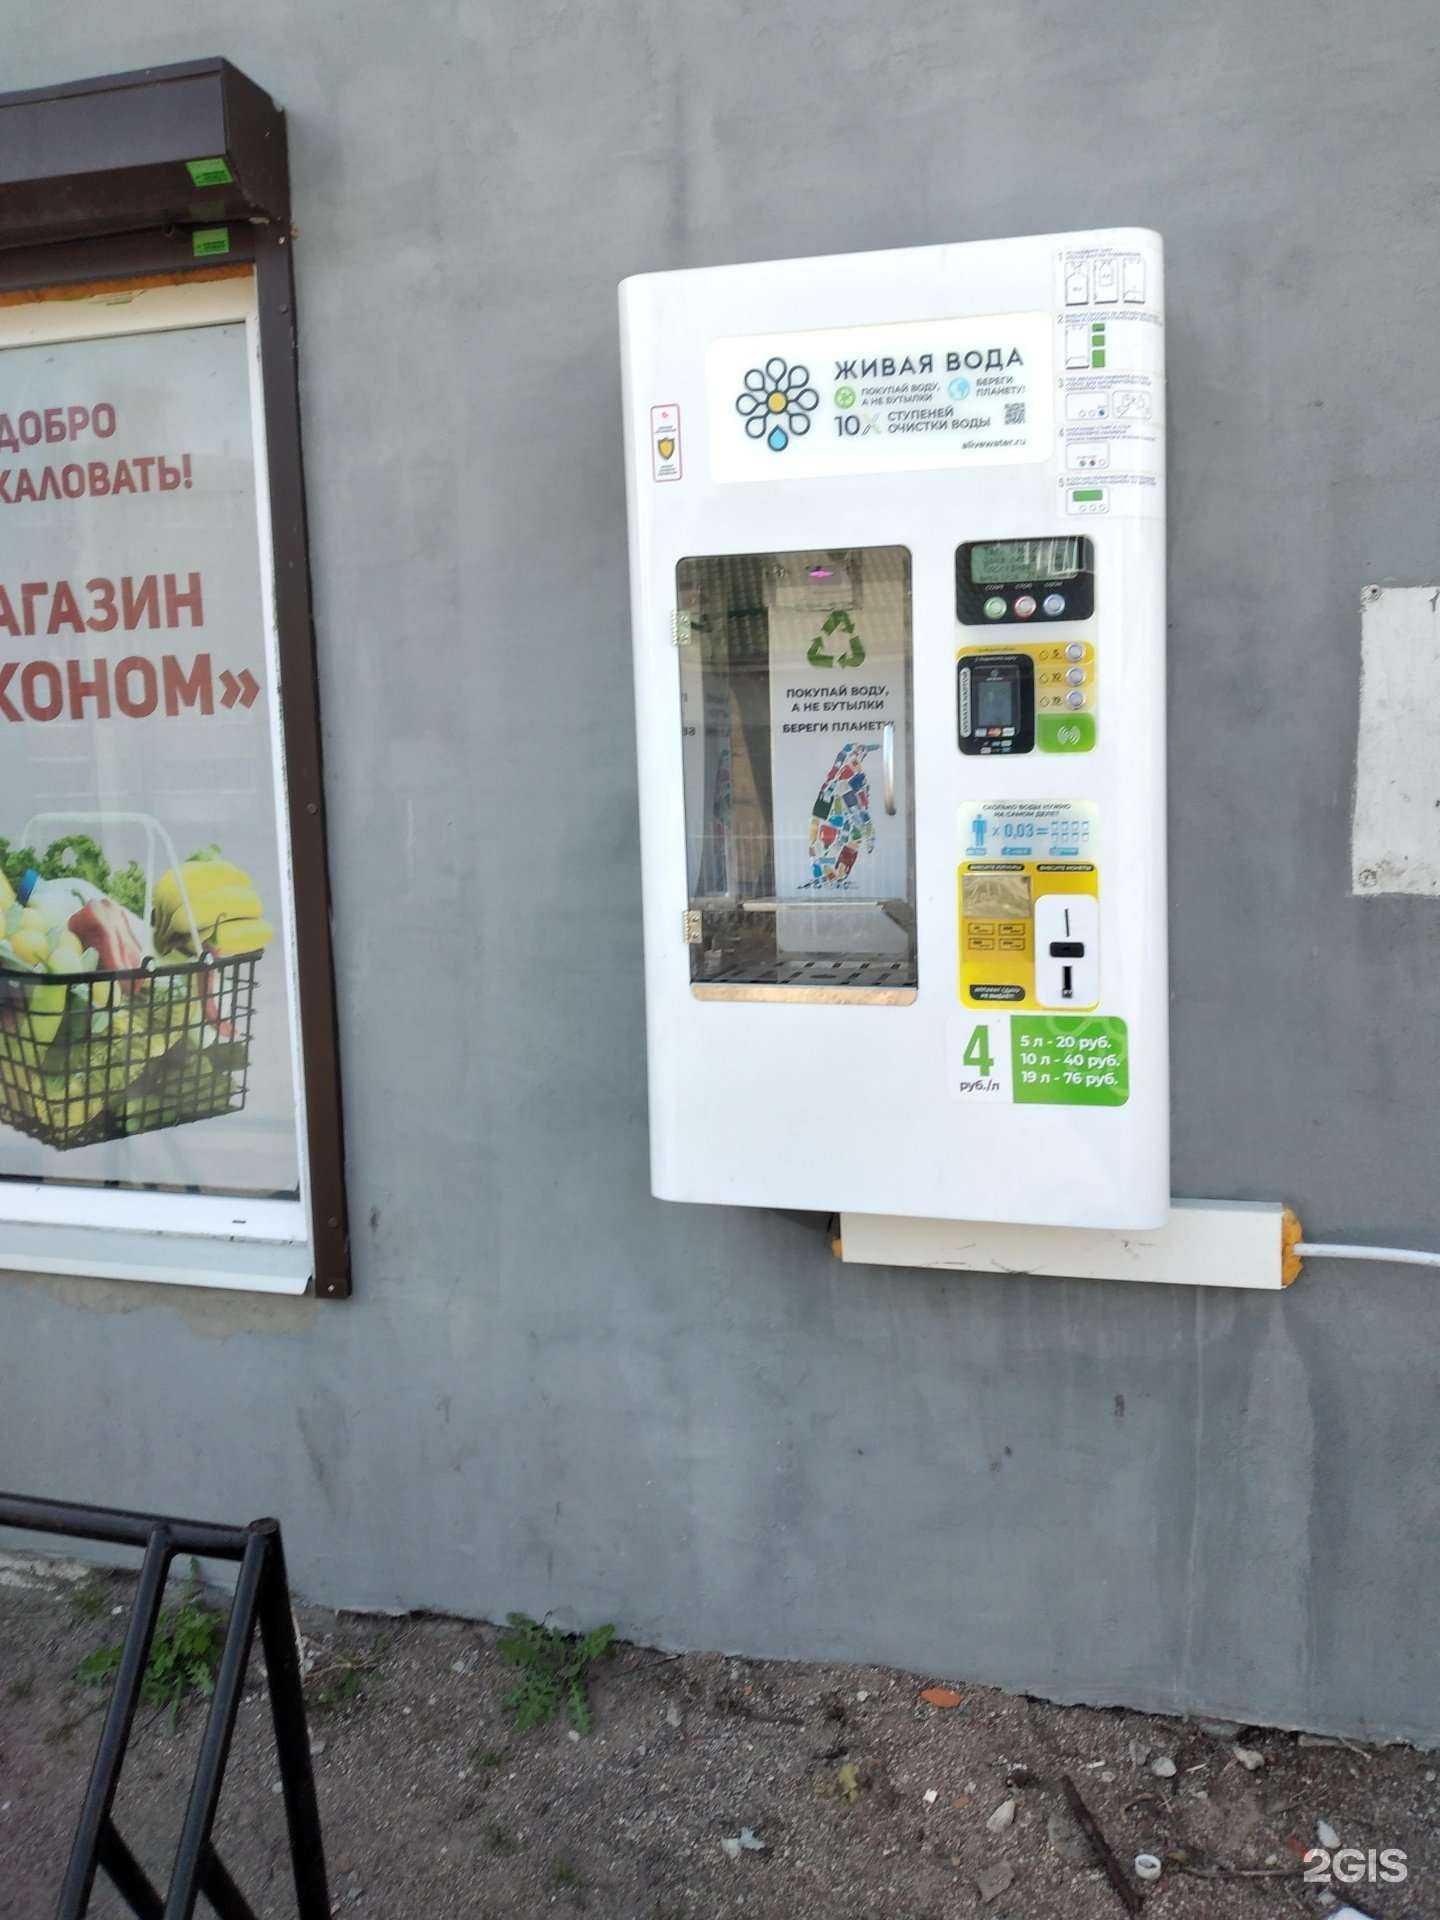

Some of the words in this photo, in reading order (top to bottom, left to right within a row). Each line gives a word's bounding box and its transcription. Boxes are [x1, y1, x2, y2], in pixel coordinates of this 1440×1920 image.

[834, 353, 934, 381] ЖИВАЯ
[946, 346, 1024, 373] ВОДА
[887, 405, 955, 423] СТУПЕНЕЙ
[0, 402, 117, 453] ДОБРО
[887, 420, 949, 434] ОЧИСТКИ
[951, 417, 992, 431] ВОДЫ
[786, 684, 848, 699] ПОКУПАЙ
[850, 684, 890, 697] ВОДУ,
[791, 702, 801, 712] А
[803, 702, 820, 712] НЕ
[823, 699, 885, 712] БУТЫЛКИ
[782, 721, 829, 734] БЕРЕГИ
[963, 1025, 994, 1077] 4
[1020, 1035, 1030, 1047] 5
[1033, 1038, 1043, 1047] л
[1056, 1036, 1075, 1048] 20
[1079, 1036, 1112, 1051] руб.
[1020, 1053, 1037, 1065] 10
[1040, 1055, 1050, 1065] л
[1063, 1054, 1084, 1066] 40
[1087, 1054, 1121, 1069] руб.
[960, 1080, 1000, 1092] руб./л
[1021, 1071, 1037, 1083] 19
[1040, 1073, 1050, 1083] л
[1063, 1072, 1082, 1084] 76
[1085, 1073, 1119, 1087] руб.
